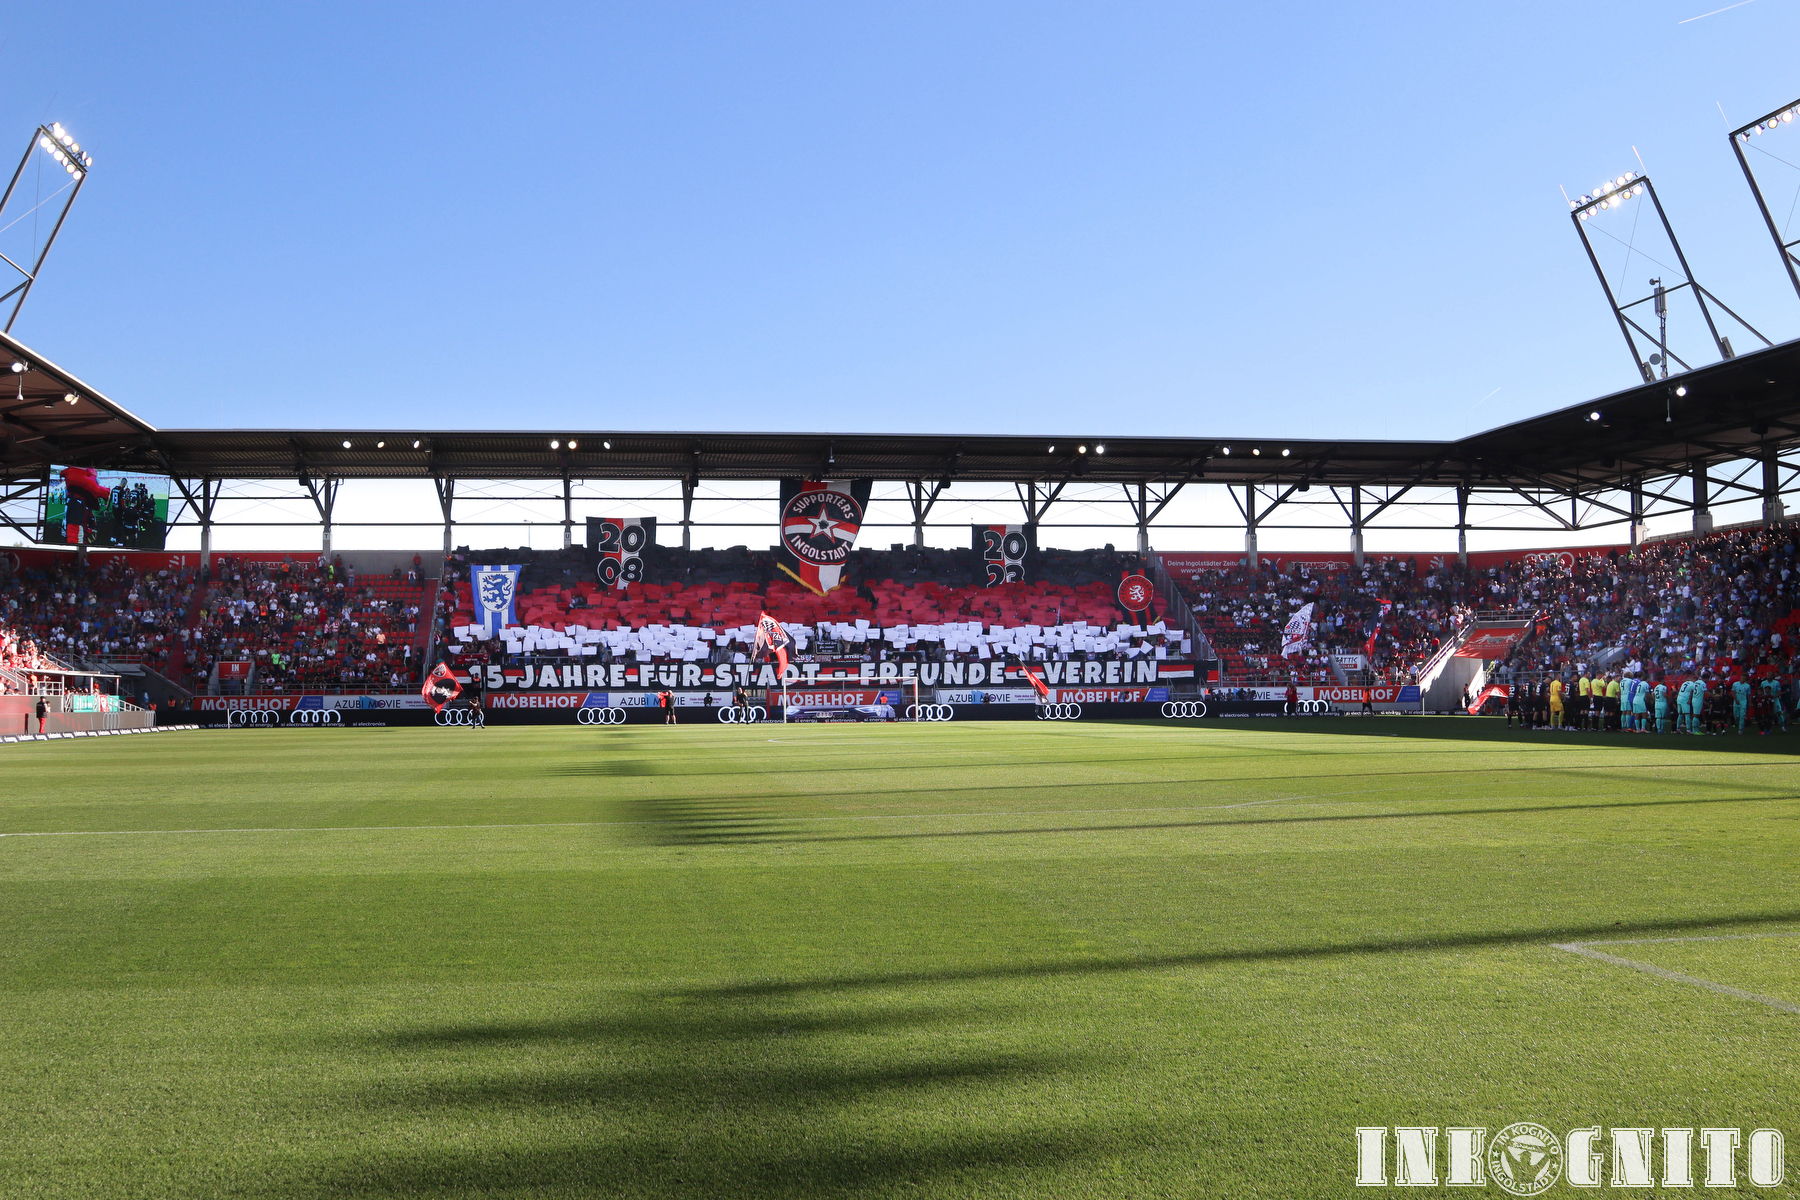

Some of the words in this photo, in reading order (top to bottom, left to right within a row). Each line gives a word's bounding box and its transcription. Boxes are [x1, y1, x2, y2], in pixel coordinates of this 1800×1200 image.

[793, 493, 854, 519] SUPPORTERS
[598, 522, 646, 554] 20
[791, 535, 851, 560] INGOLSTADT
[983, 530, 1027, 562] 20
[597, 556, 644, 586] 08
[1186, 560, 1222, 568] Ingolstädter
[468, 664, 504, 689] 15
[518, 663, 625, 688] JAHRE
[715, 663, 821, 687] STADT
[859, 661, 1006, 686] FREUNDE
[1043, 660, 1158, 684] VEREIN
[200, 697, 291, 710] MÖBELHOF
[334, 699, 364, 709] AZUBI
[368, 699, 401, 709] MOVIE
[492, 694, 578, 708] MÖBELHOF
[620, 697, 649, 706] AZUBI
[777, 692, 864, 706] MÖBELHOF
[948, 694, 976, 703] AZUBI
